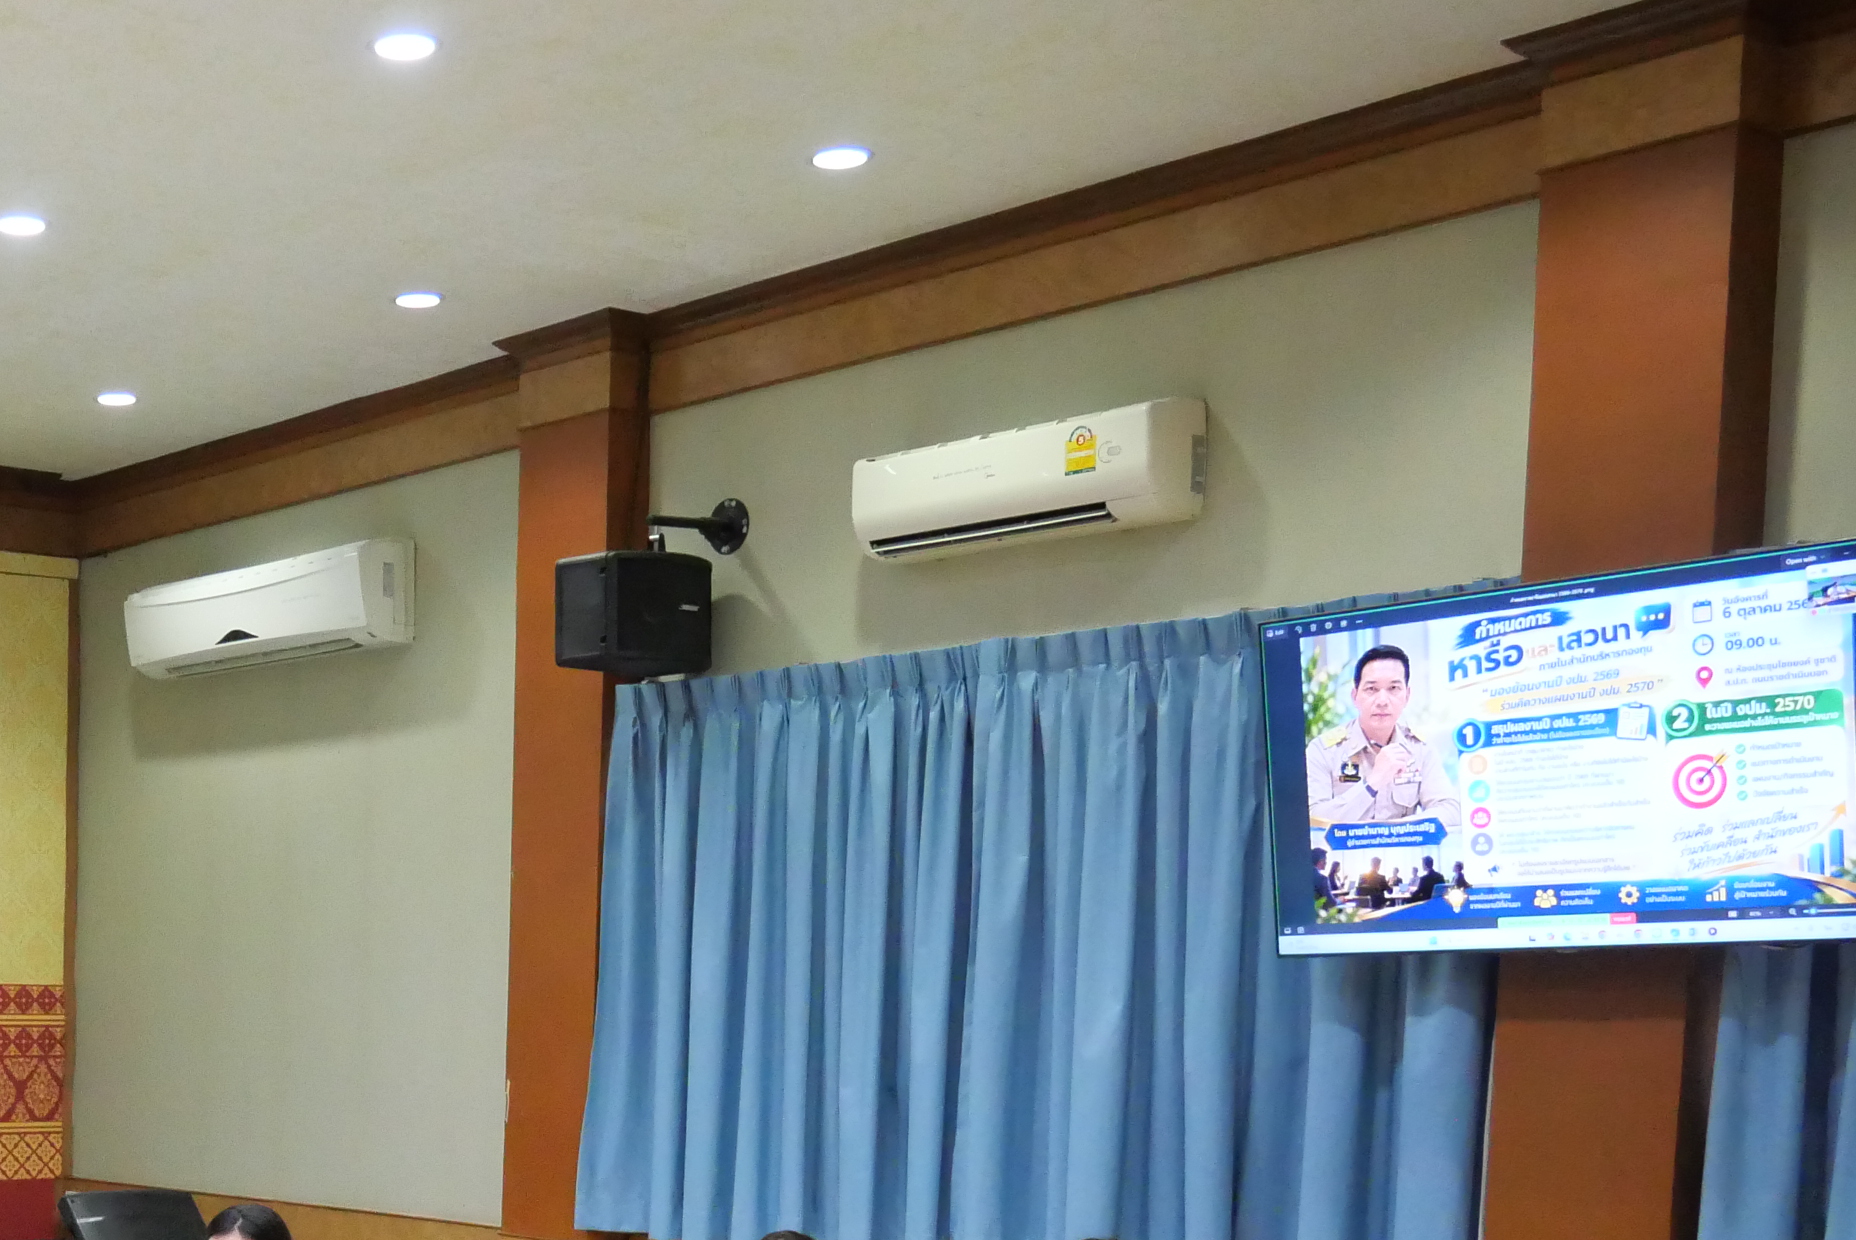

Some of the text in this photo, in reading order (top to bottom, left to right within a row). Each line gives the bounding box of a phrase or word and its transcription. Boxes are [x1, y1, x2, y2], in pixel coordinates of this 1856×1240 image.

[1722, 598, 1808, 620] 6 ตุลาคม 256
[1474, 611, 1553, 640] กำหนดการ
[1447, 639, 1524, 683] หารือ
[1557, 622, 1631, 652] เสวนา
[1725, 636, 1765, 651] 09.00
[1593, 669, 1620, 682] 2569
[1671, 706, 1689, 729] 2
[1704, 702, 1732, 719] ในปี
[1774, 694, 1815, 713] 2570
[1578, 712, 1605, 727] 2569
[1462, 725, 1474, 745] 1
